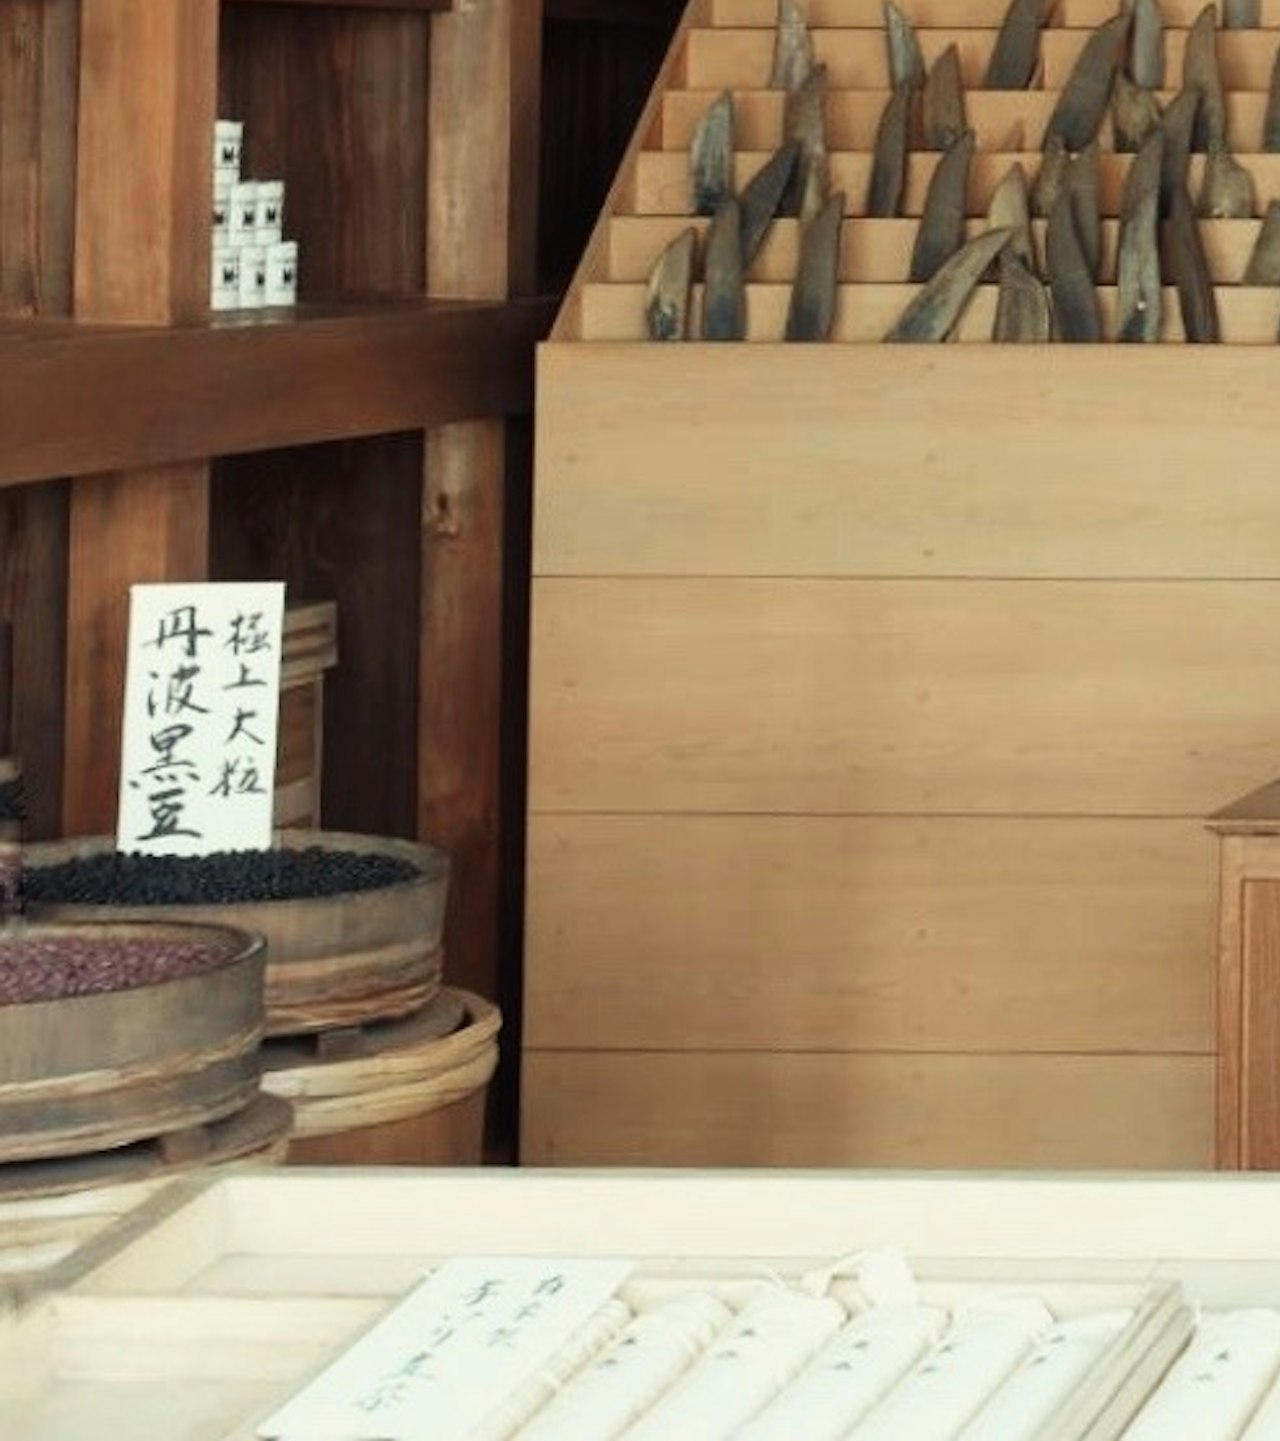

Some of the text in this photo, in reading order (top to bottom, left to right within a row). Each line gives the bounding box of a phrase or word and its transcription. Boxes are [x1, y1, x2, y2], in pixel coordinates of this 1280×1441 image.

[128, 605, 214, 842] 丹波黒豆
[208, 611, 272, 796] 極上大粒
